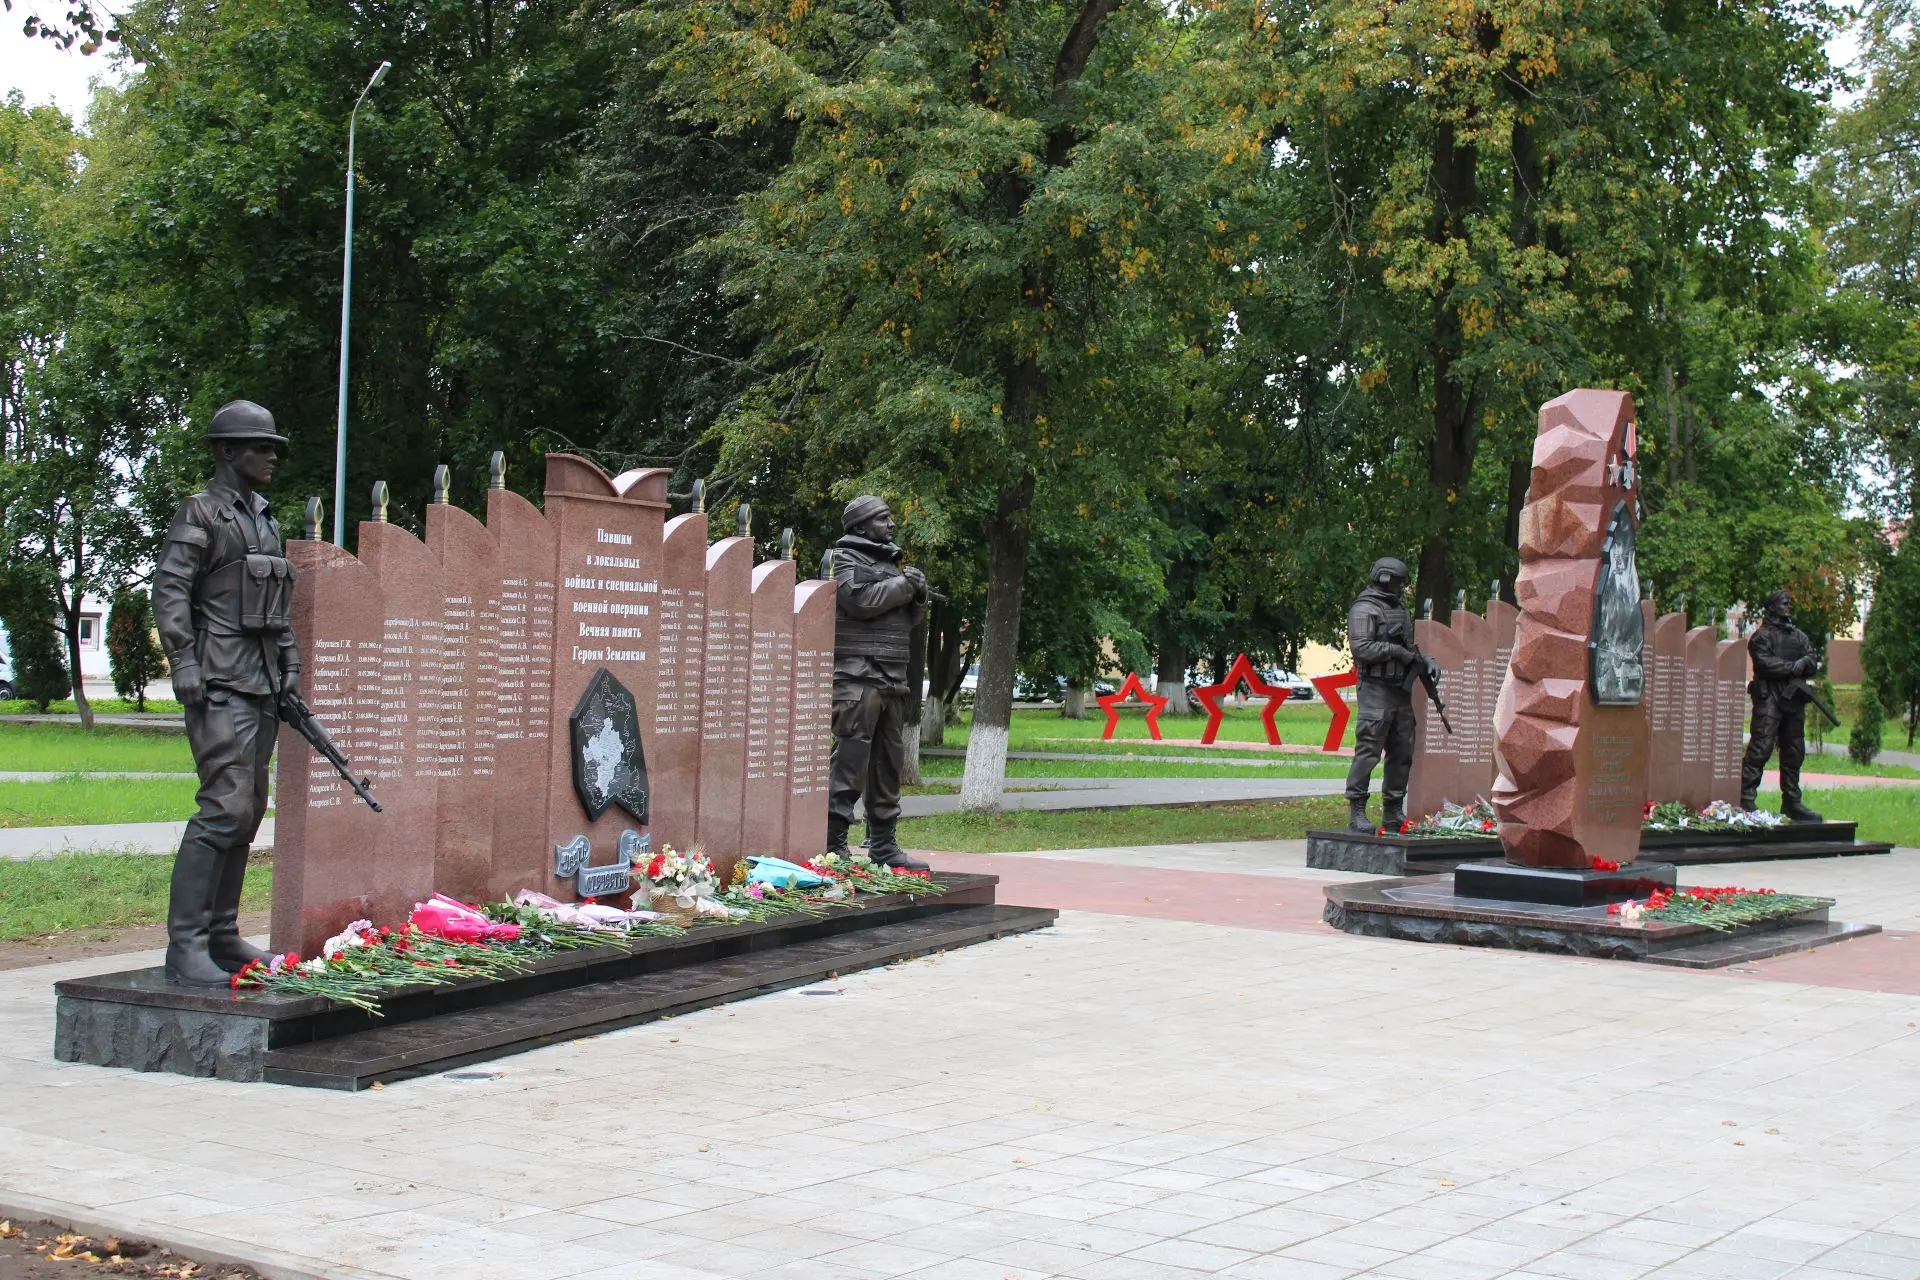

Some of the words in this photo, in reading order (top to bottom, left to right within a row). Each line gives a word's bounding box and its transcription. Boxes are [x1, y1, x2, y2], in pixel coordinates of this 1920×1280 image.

[597, 528, 632, 545] Павшим
[586, 555, 592, 565] в
[594, 555, 640, 569] локальных
[565, 575, 596, 590] войнах
[598, 580, 604, 590] и
[606, 580, 658, 593] специальной
[573, 600, 608, 614] военной
[611, 603, 649, 618] операции
[579, 622, 610, 637] Вечная
[612, 626, 642, 638] память
[572, 646, 603, 664] Героям
[605, 646, 646, 661] Землякам
